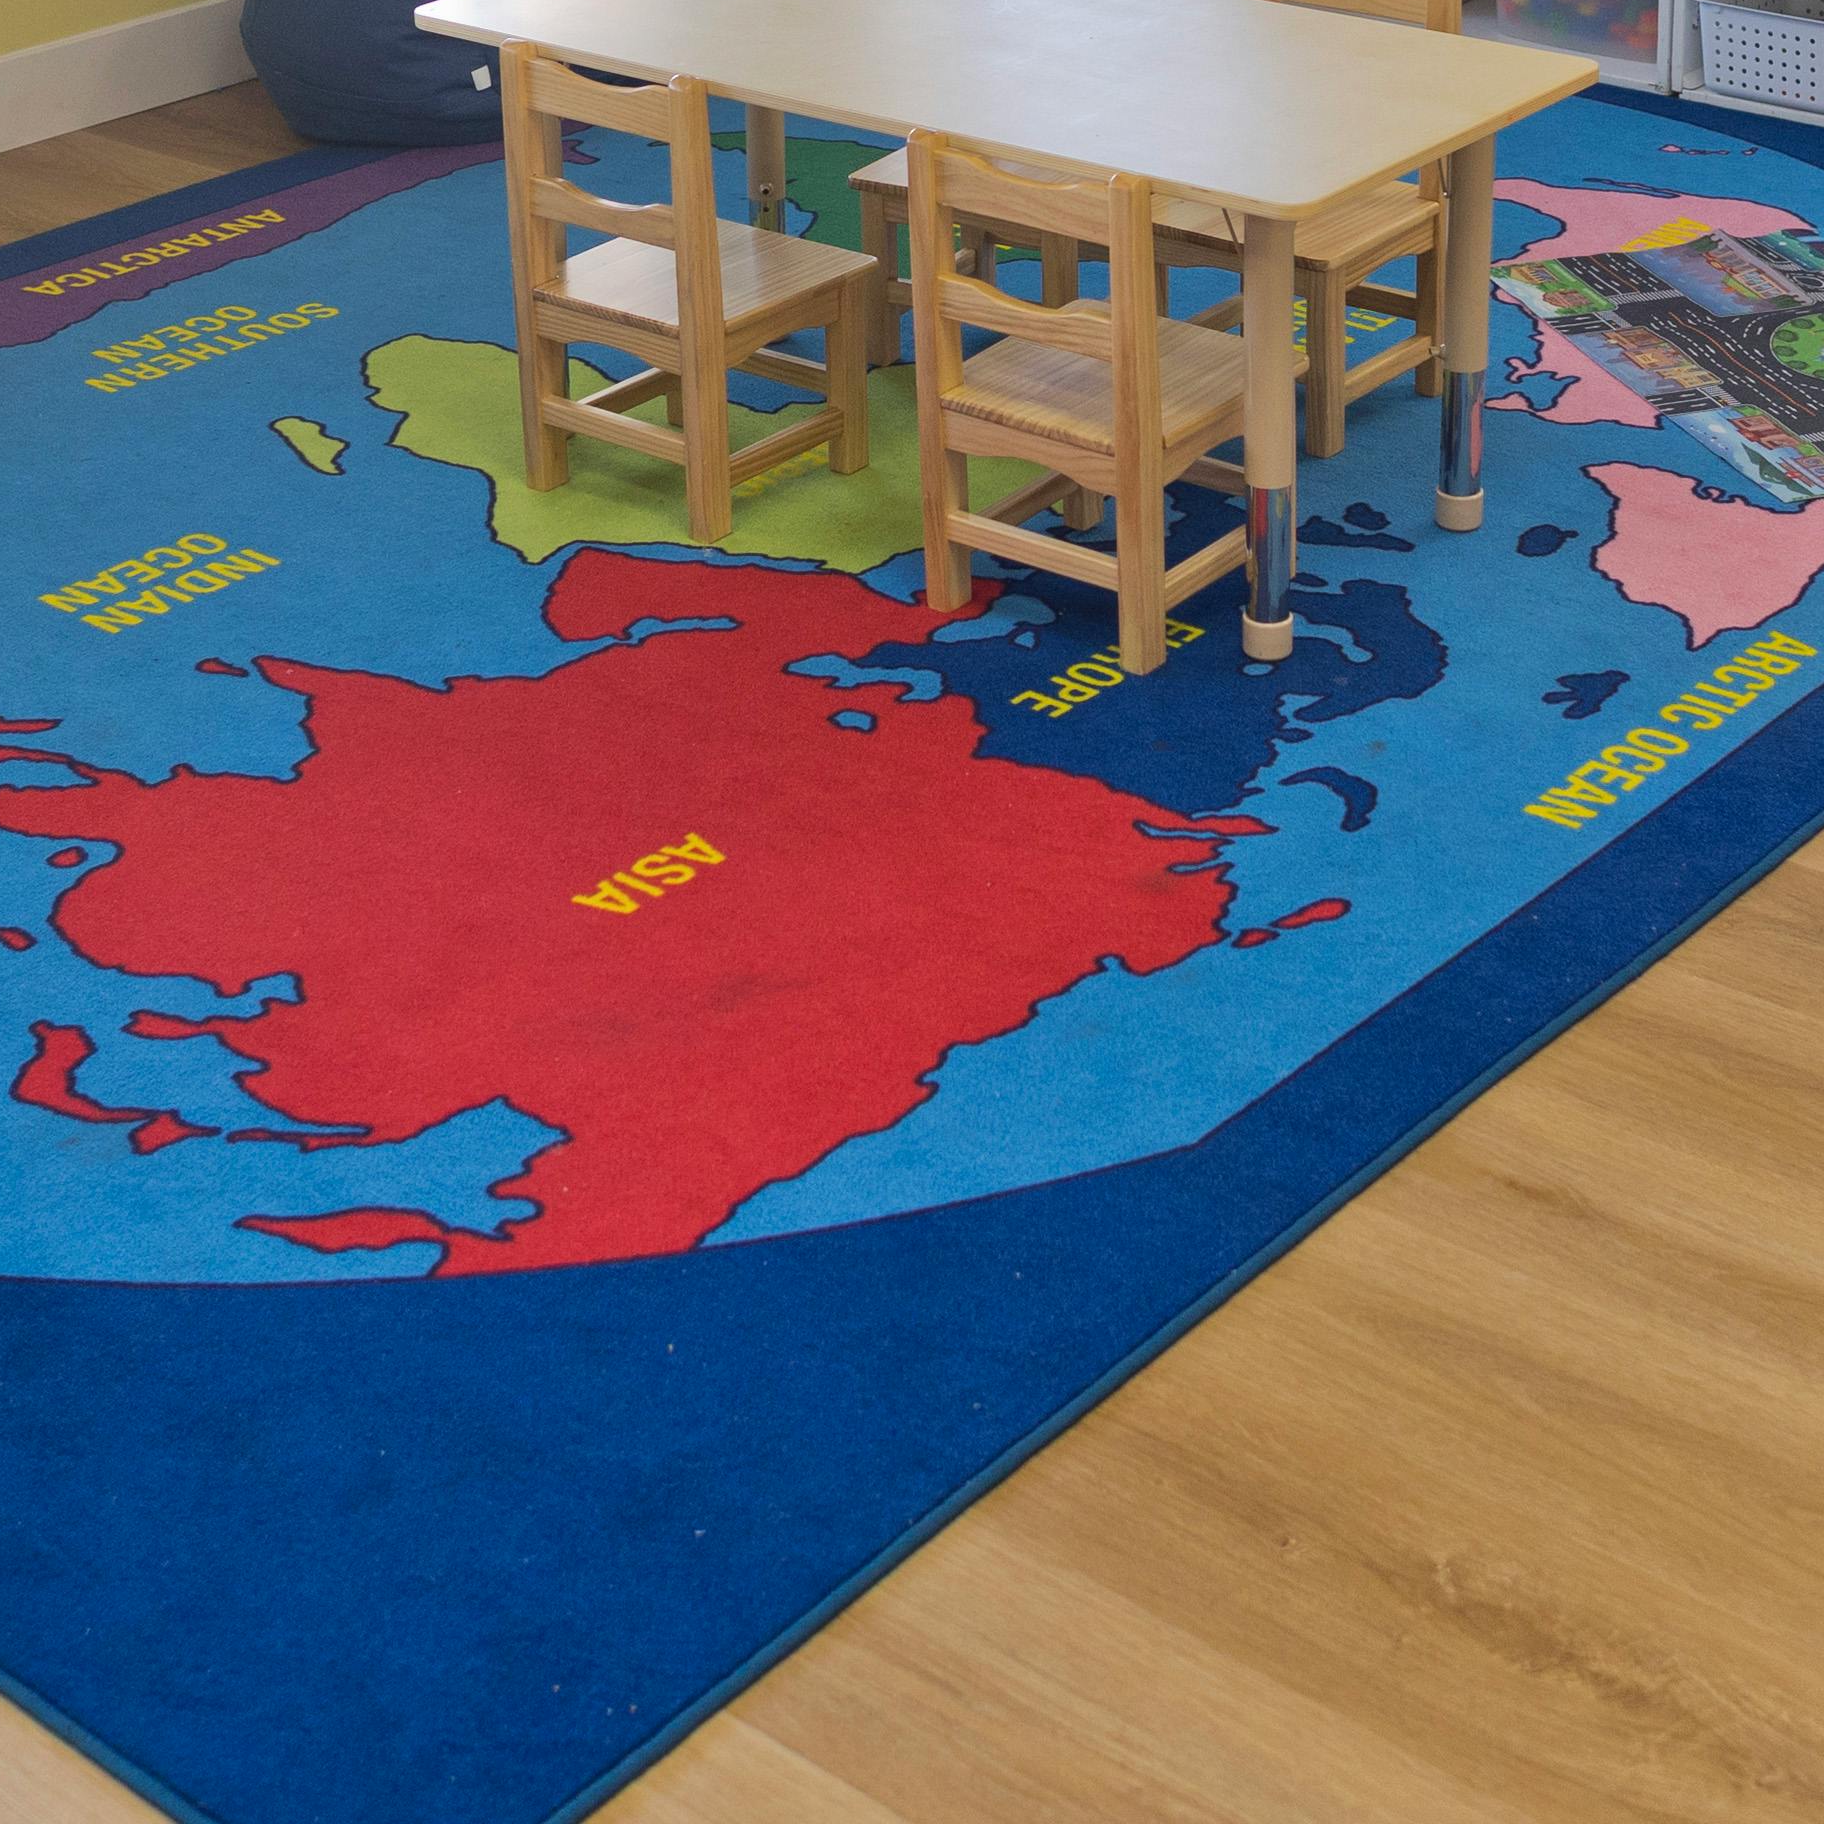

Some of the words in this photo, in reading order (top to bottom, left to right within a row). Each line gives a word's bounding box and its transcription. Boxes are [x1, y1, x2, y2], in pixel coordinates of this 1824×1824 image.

[22, 208, 287, 297] ANTARCTICA
[84, 302, 340, 393] SOUTHERN
[90, 305, 257, 364] OCEAN
[37, 532, 229, 614] OCEAN
[79, 548, 281, 634] INDIAN
[1659, 630, 1818, 730] ARCTIC
[1523, 728, 1689, 829] OCEAN
[572, 831, 728, 916] ASIA
